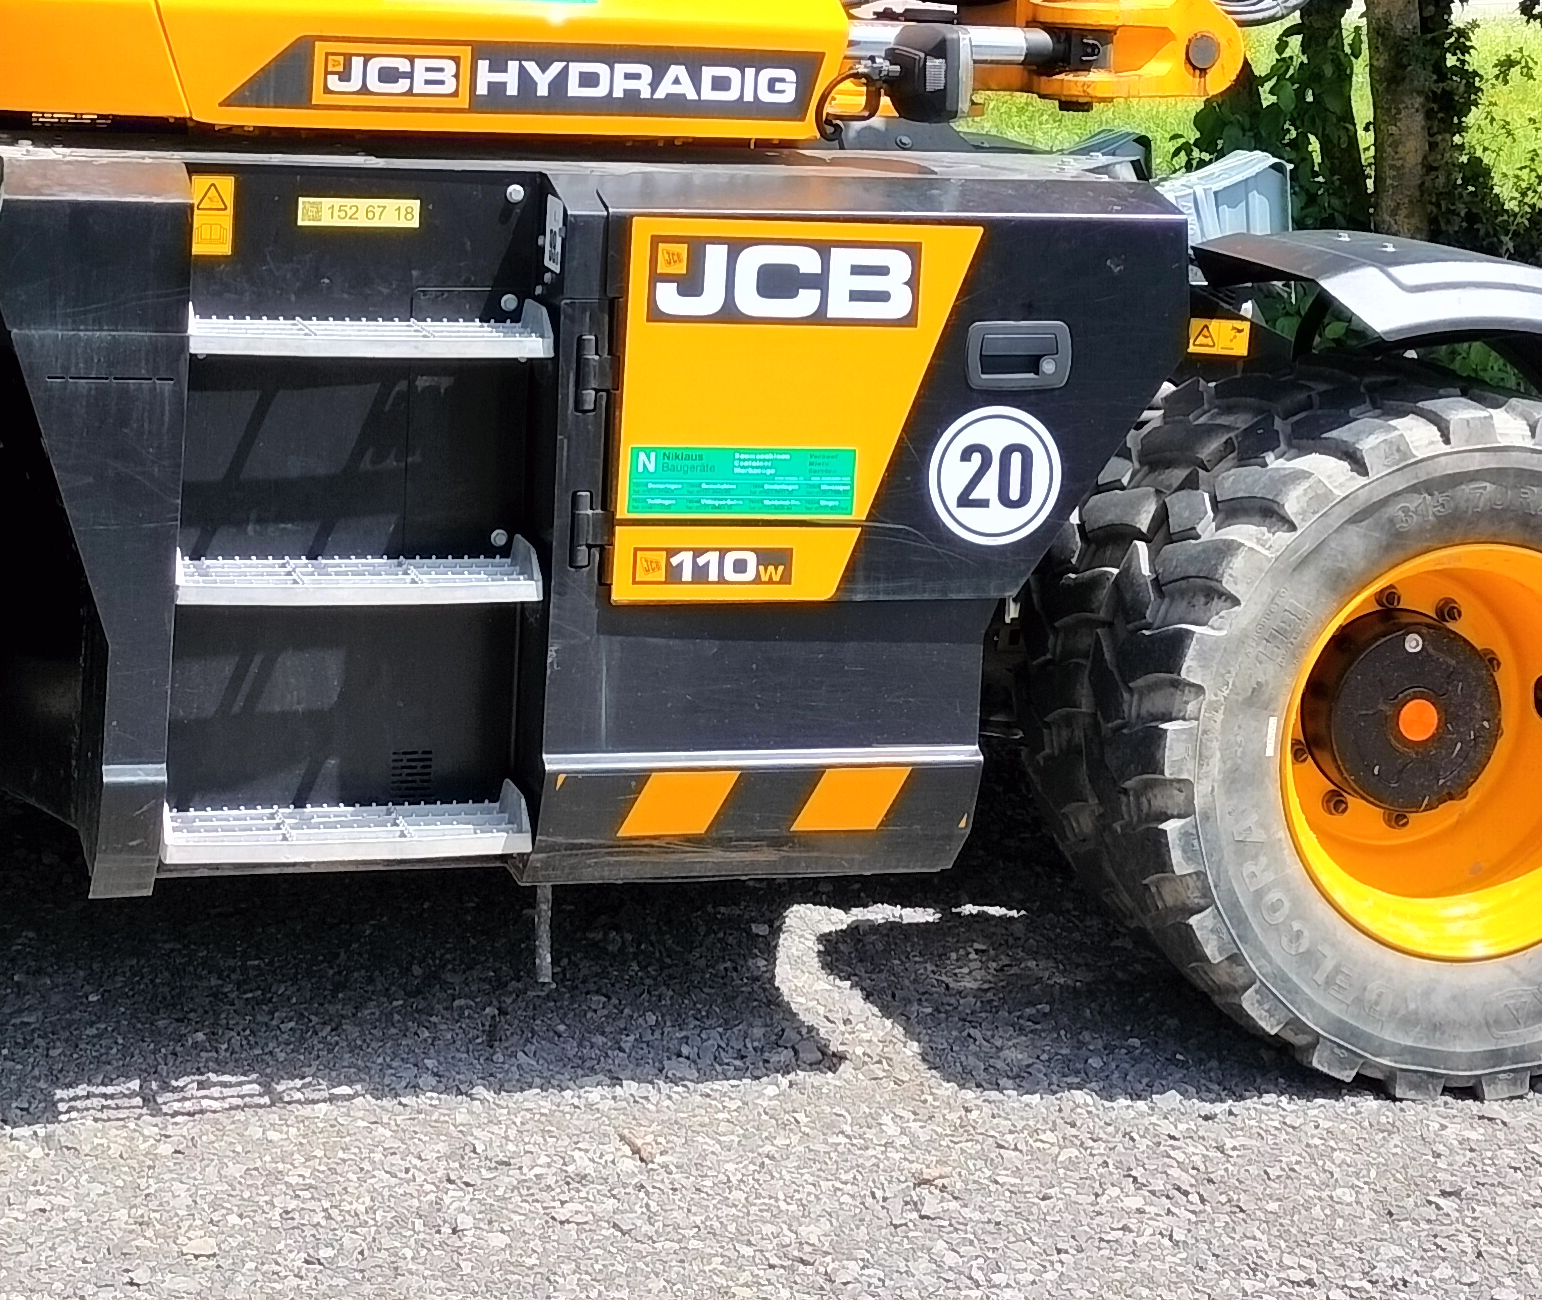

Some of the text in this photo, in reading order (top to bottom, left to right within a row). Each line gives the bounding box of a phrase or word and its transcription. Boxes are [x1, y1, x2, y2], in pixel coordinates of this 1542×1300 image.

[326, 56, 797, 104] JCB HYDRADIG
[327, 203, 415, 222] 152 67 18
[655, 243, 913, 320] JCB
[637, 451, 657, 473] N
[661, 462, 716, 474] Baugeräte
[662, 452, 704, 462] Niklaus
[956, 443, 1034, 509] 20
